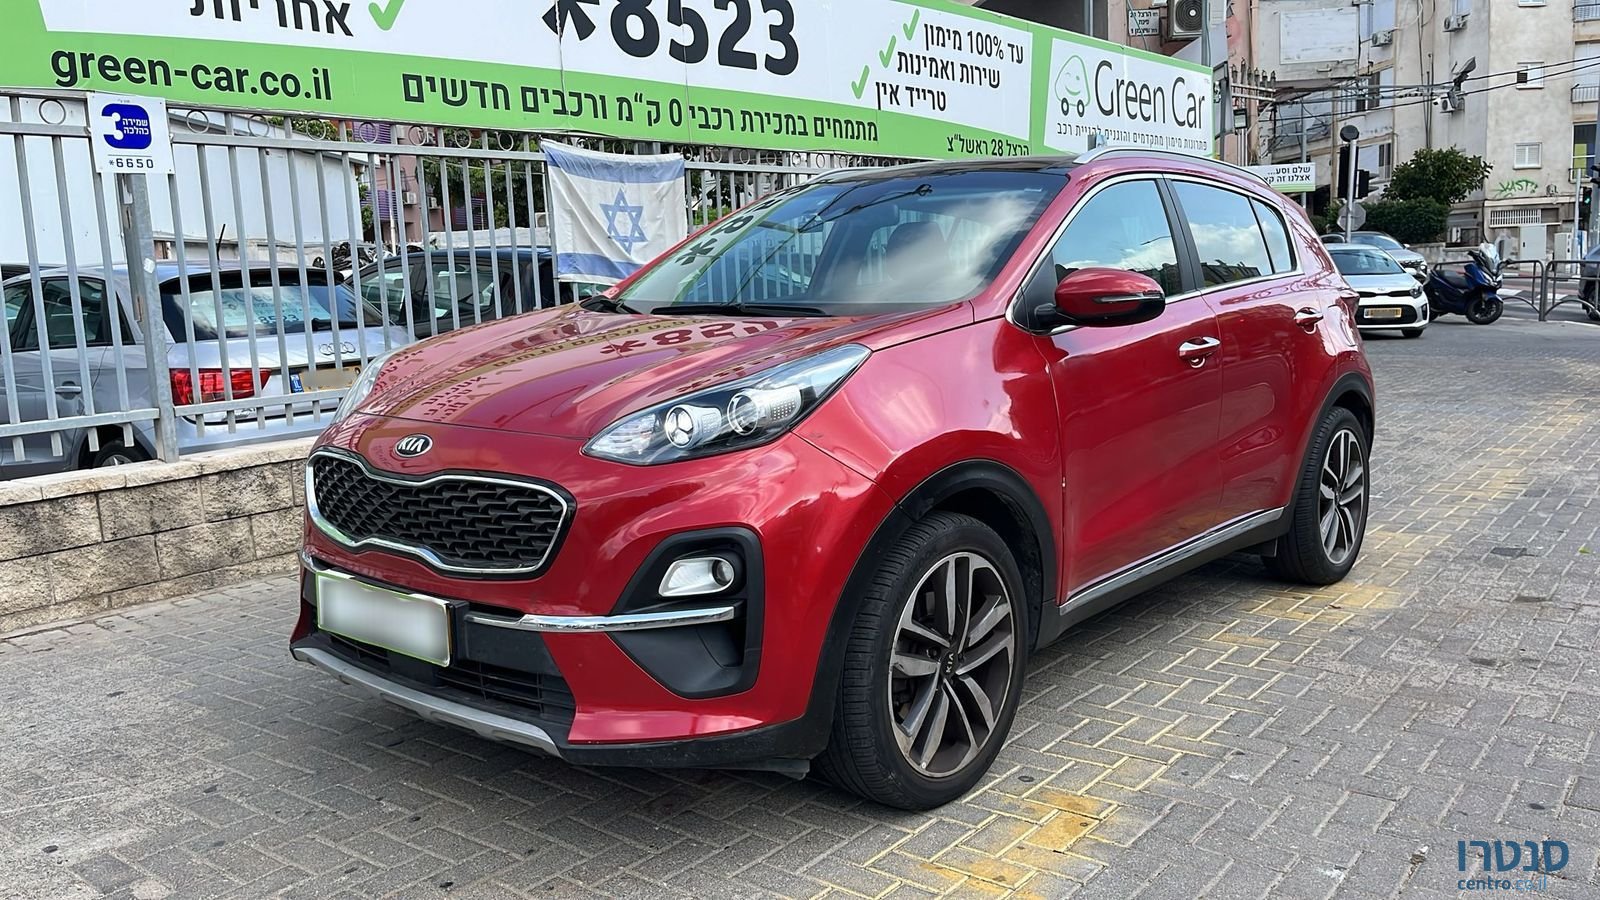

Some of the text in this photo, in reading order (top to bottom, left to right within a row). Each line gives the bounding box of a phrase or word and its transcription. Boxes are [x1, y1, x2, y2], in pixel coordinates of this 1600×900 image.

[923, 23, 1024, 64] עד 100% מימון
[51, 49, 332, 100] green-car.co.il
[897, 50, 1000, 89] שירות ואמינות
[402, 73, 511, 111] חדשים
[875, 81, 946, 112] טרייד אין
[1095, 60, 1205, 129] Green Car
[520, 86, 608, 120] ורכבים
[669, 98, 683, 127] 0
[688, 105, 735, 131] רכבי
[122, 118, 148, 126] שמירה
[123, 126, 149, 135] כהלכה
[740, 110, 809, 137] במכירת
[813, 116, 878, 142] מתמחים
[1057, 122, 1072, 135] רכב
[1105, 128, 1130, 142] והוגנים
[1132, 132, 1164, 148] מתקדמים
[1165, 136, 1182, 150] מימון
[991, 139, 1004, 157] 28
[1005, 139, 1030, 156] הרצל
[1184, 138, 1207, 151] פתרונות
[1288, 174, 1311, 182] אצלנו
[1292, 166, 1311, 174] שלם
[398, 437, 426, 452] KIA
